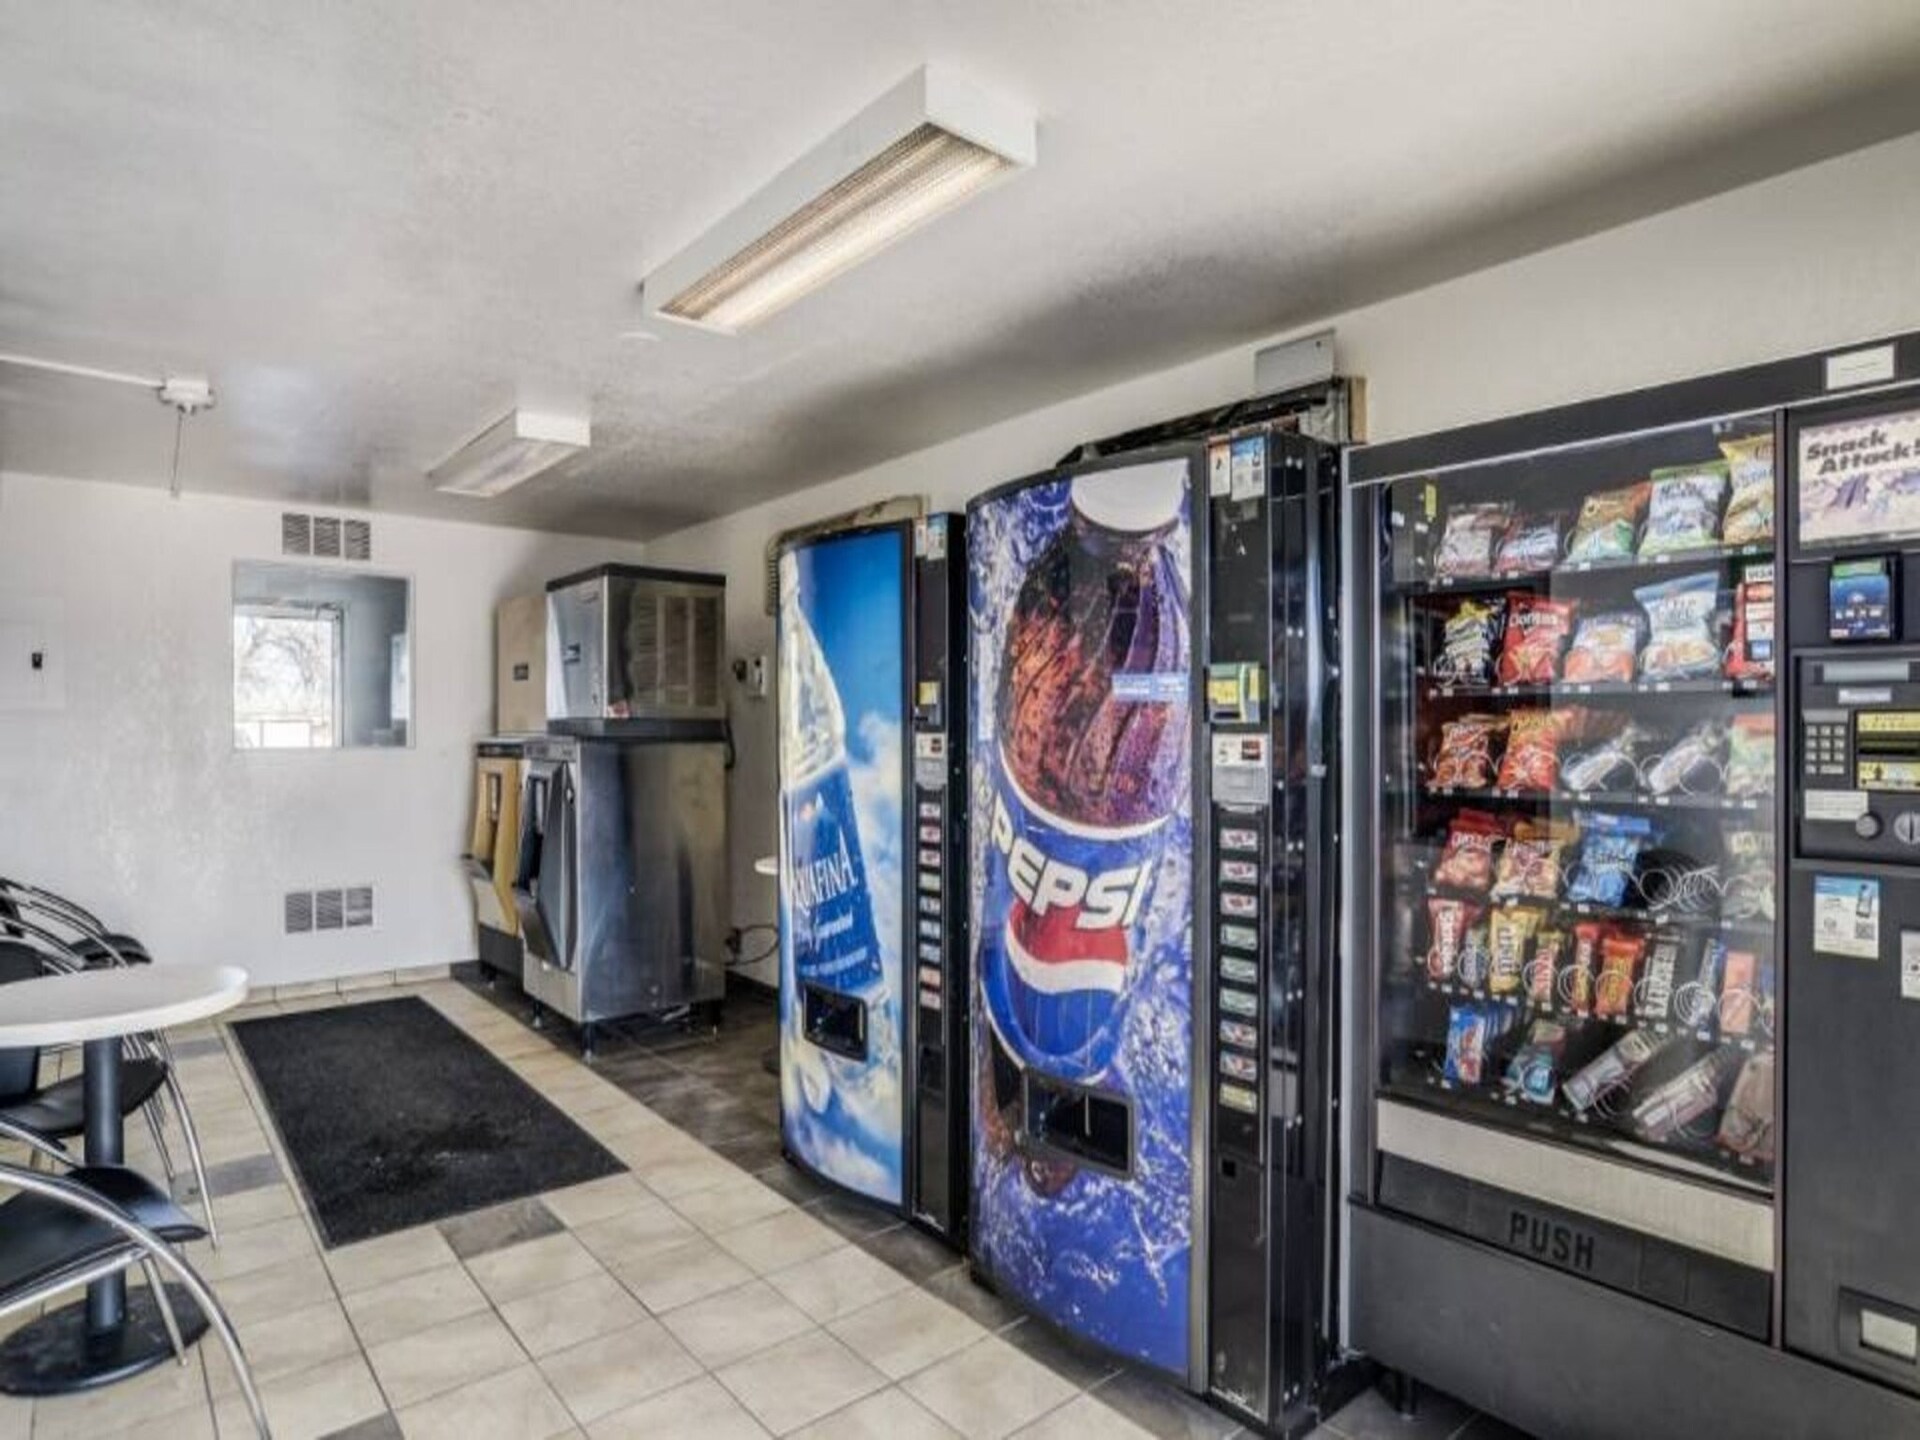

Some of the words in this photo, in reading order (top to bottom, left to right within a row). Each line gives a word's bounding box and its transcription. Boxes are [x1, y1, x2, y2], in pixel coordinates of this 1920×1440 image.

[1807, 429, 1888, 460] Snack
[793, 827, 859, 917] QUAFINA
[991, 790, 1153, 931] PEPSI
[1509, 1211, 1595, 1270] PUSH
